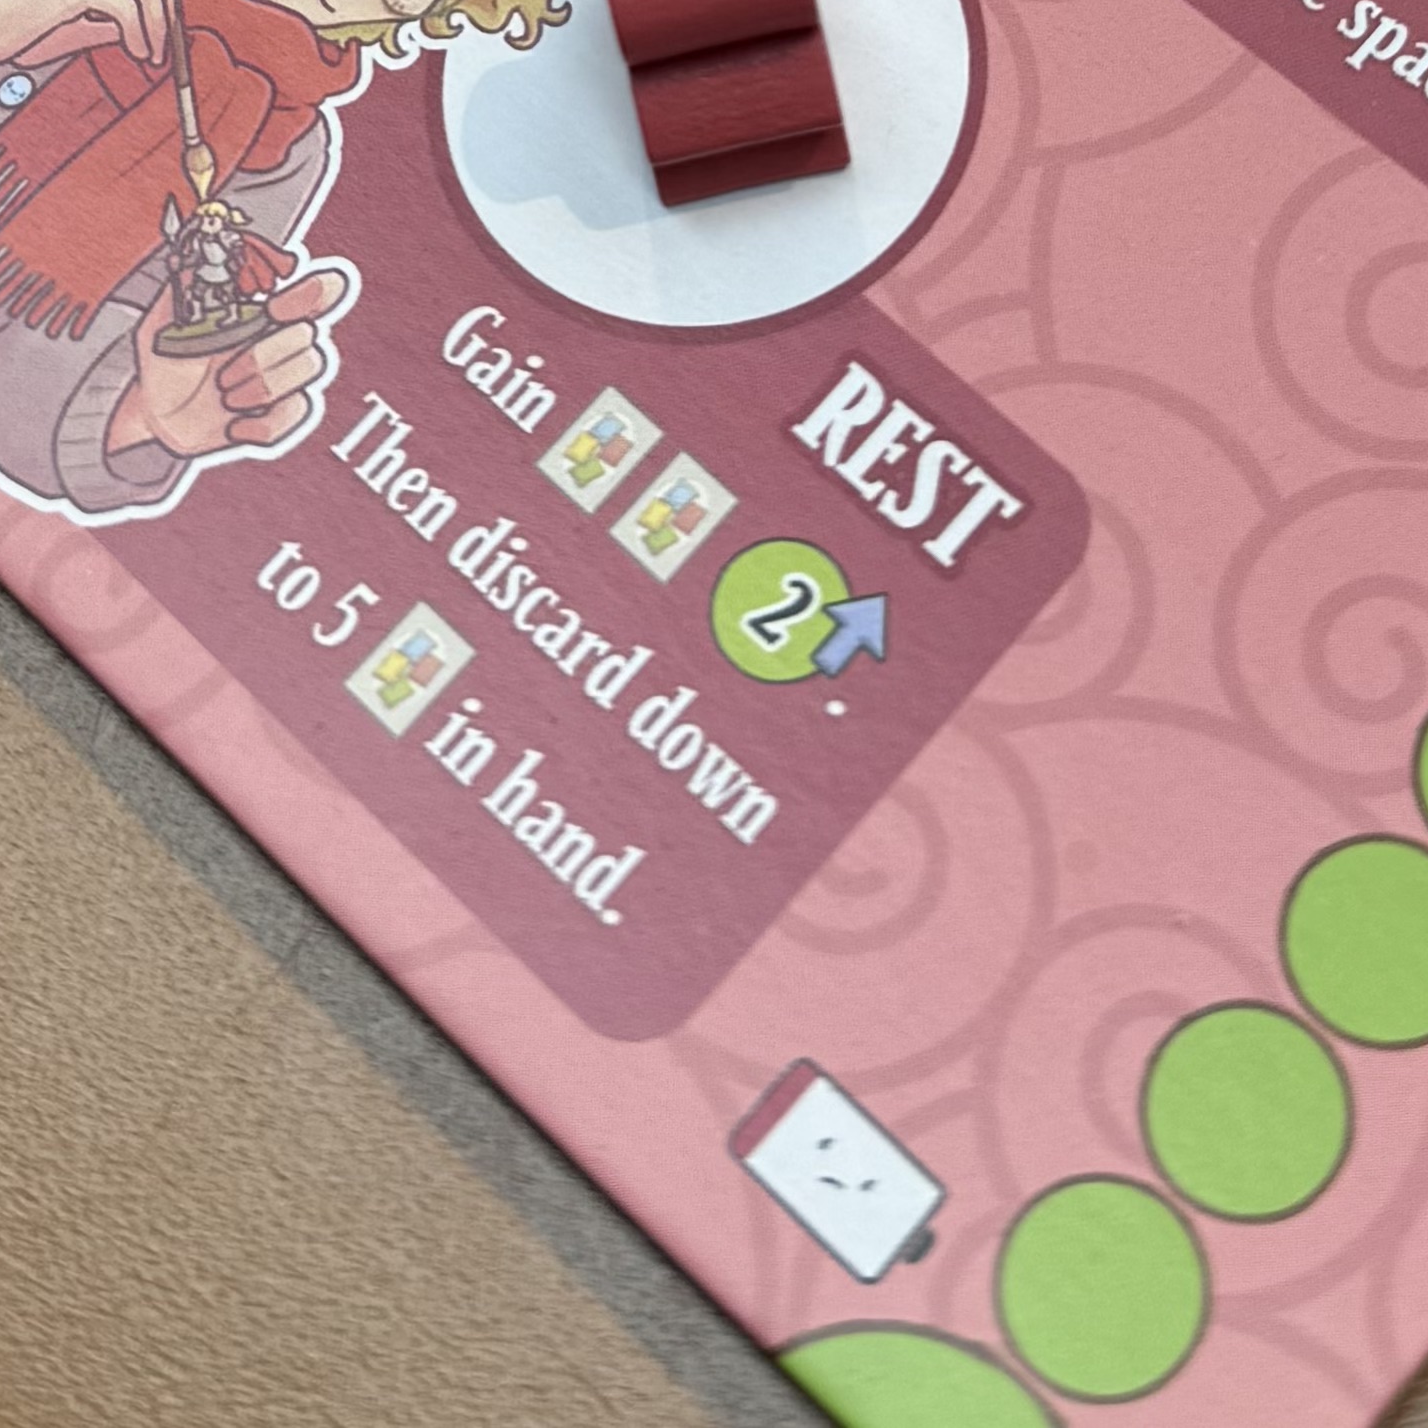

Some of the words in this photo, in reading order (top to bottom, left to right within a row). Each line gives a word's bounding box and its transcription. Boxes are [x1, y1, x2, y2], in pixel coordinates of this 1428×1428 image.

[330, 391, 460, 543] Then
[447, 517, 652, 710] discard
[627, 688, 782, 847] down
[440, 305, 559, 435] Gain
[747, 576, 819, 648] 2
[789, 360, 1026, 568] REST
[255, 542, 323, 611] to
[311, 583, 381, 648] 5
[424, 698, 489, 787] in
[481, 749, 649, 926] hand.
